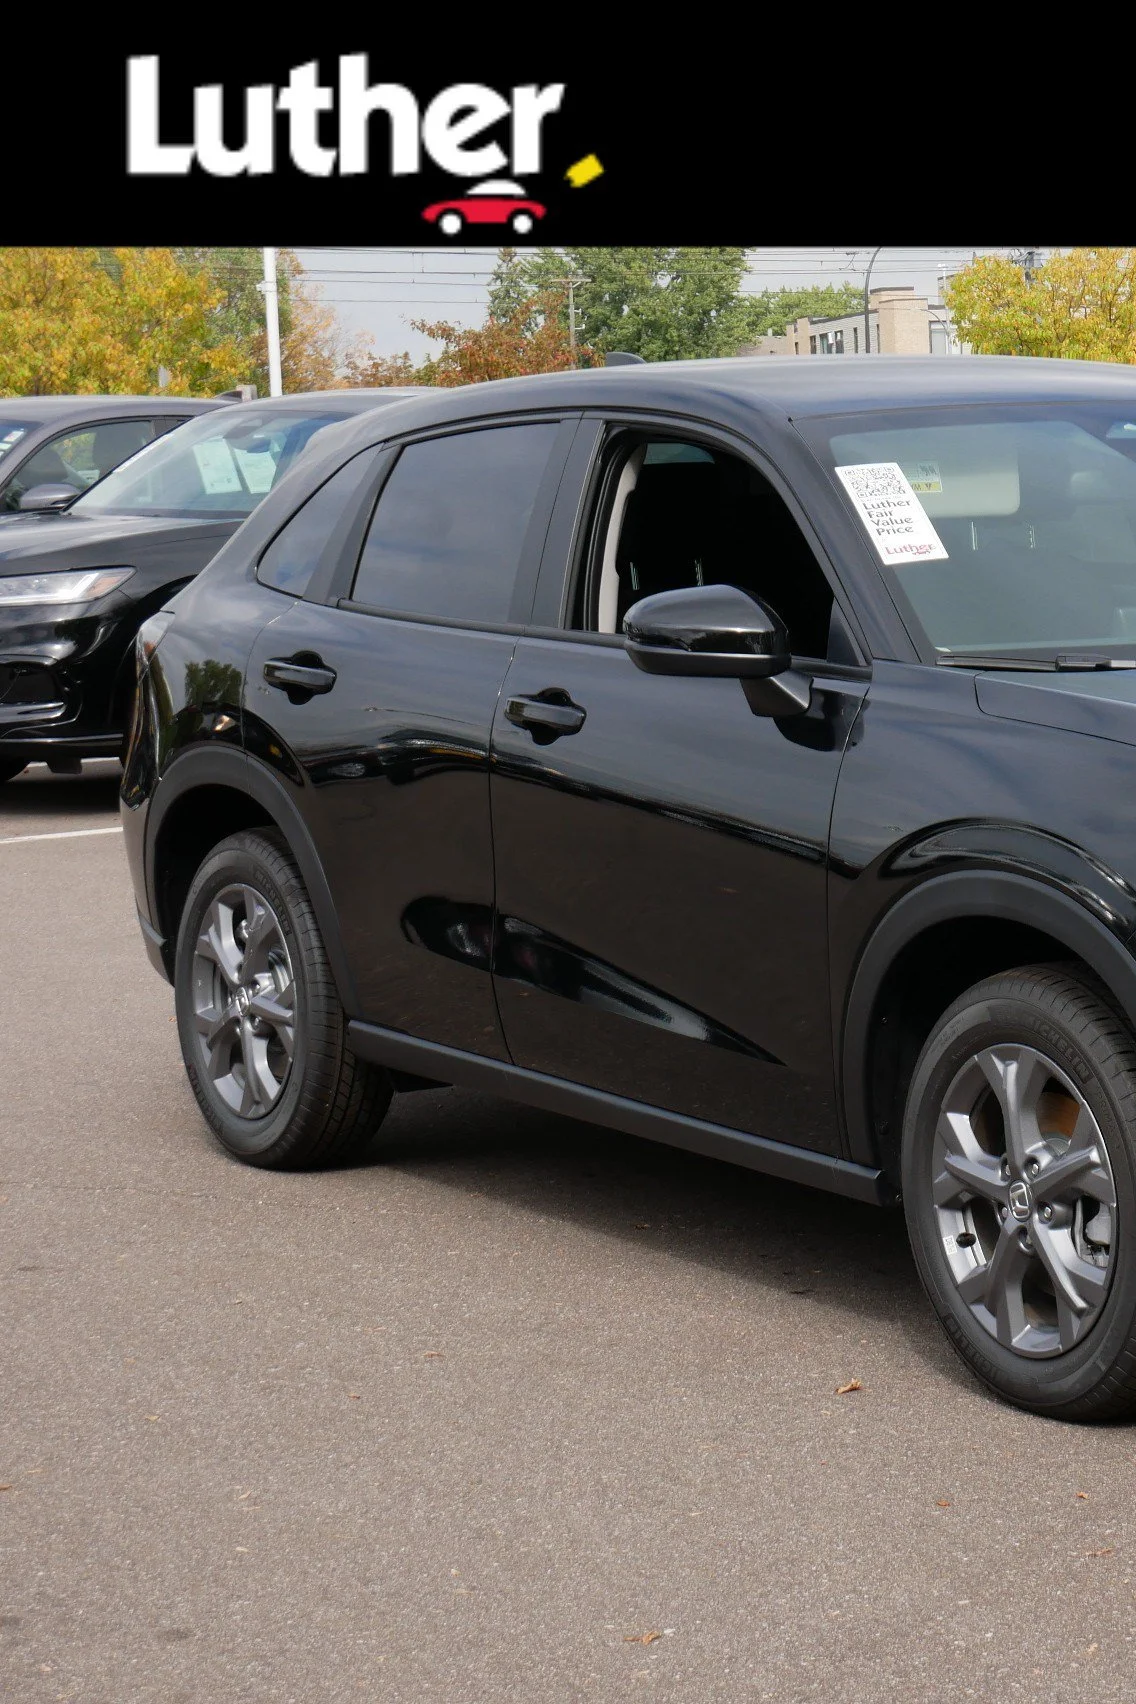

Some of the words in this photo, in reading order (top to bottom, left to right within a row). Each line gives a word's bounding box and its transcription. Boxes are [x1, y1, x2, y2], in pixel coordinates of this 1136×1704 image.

[862, 500, 911, 510] Luther
[867, 510, 894, 519] Fair
[871, 517, 914, 526] Value
[876, 526, 914, 536] Price
[885, 543, 934, 555] Luther
